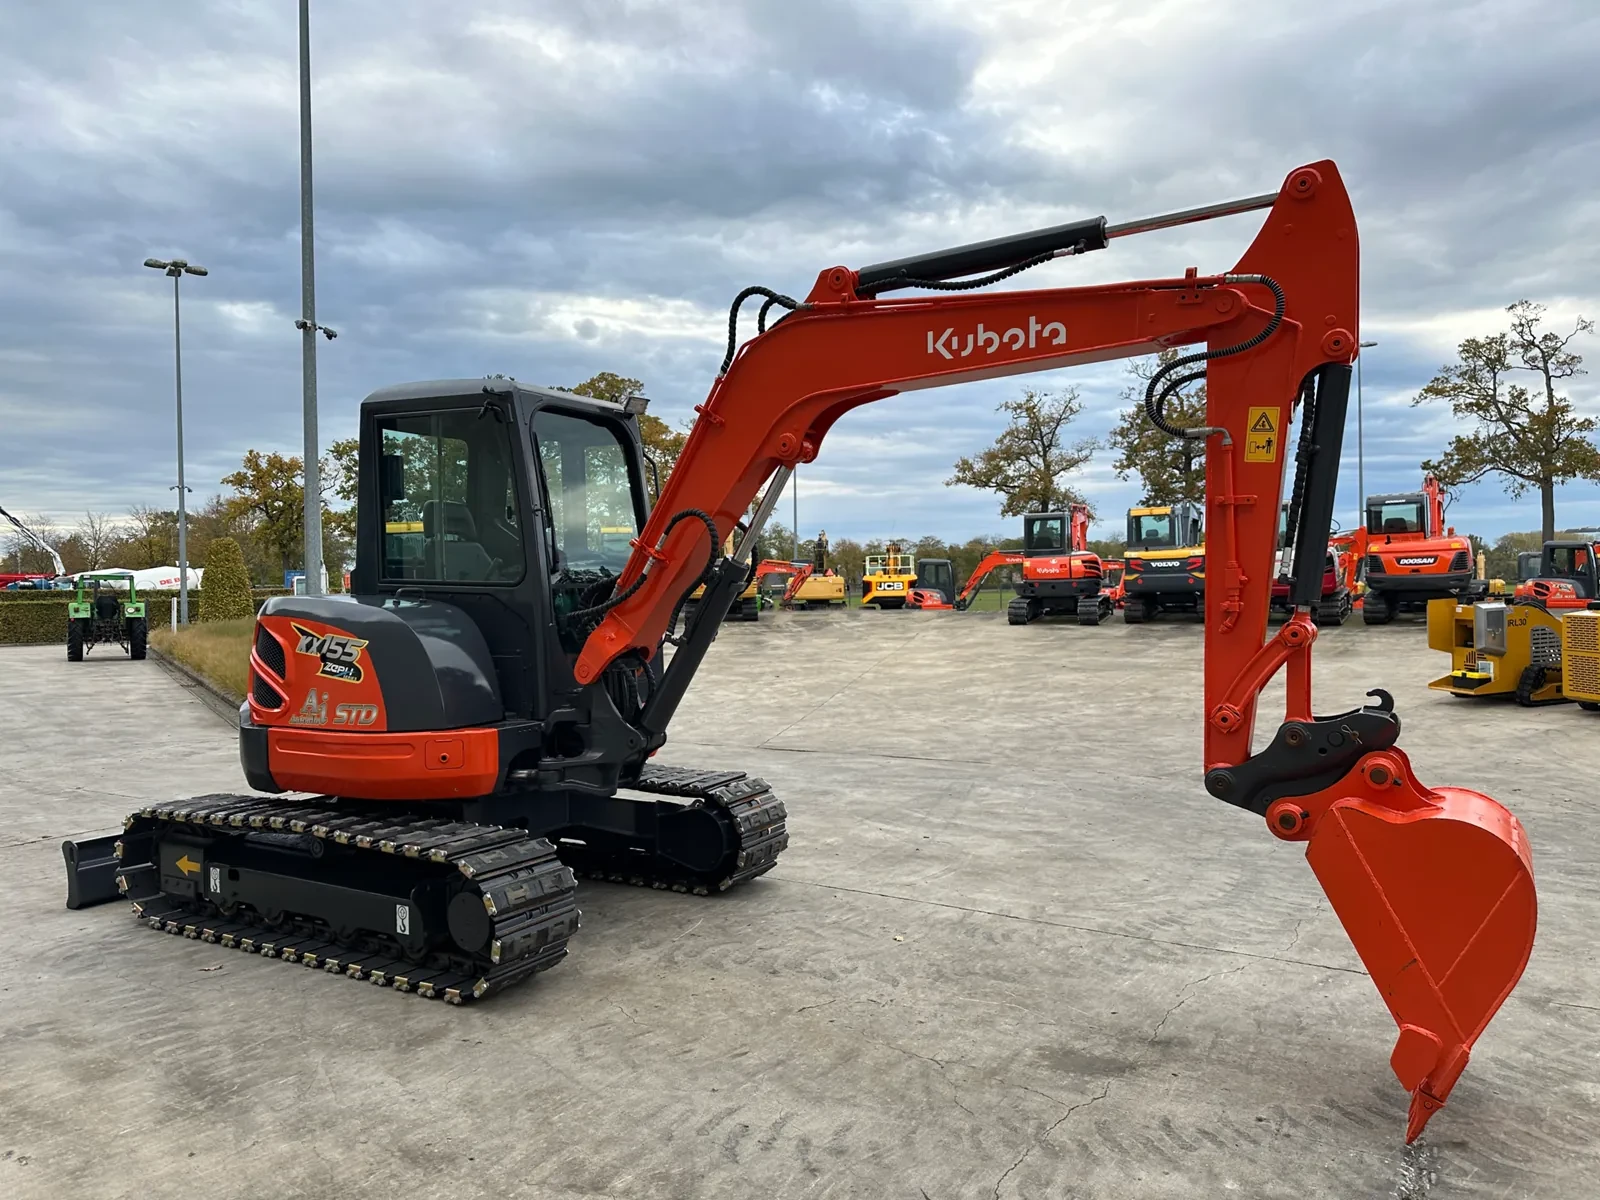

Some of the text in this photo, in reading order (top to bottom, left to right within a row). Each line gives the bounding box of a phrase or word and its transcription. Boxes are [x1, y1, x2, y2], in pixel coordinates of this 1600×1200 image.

[927, 316, 1066, 359] Kubota
[876, 582, 904, 590] JCB
[297, 635, 365, 662] KX155
[334, 704, 378, 725] STD
